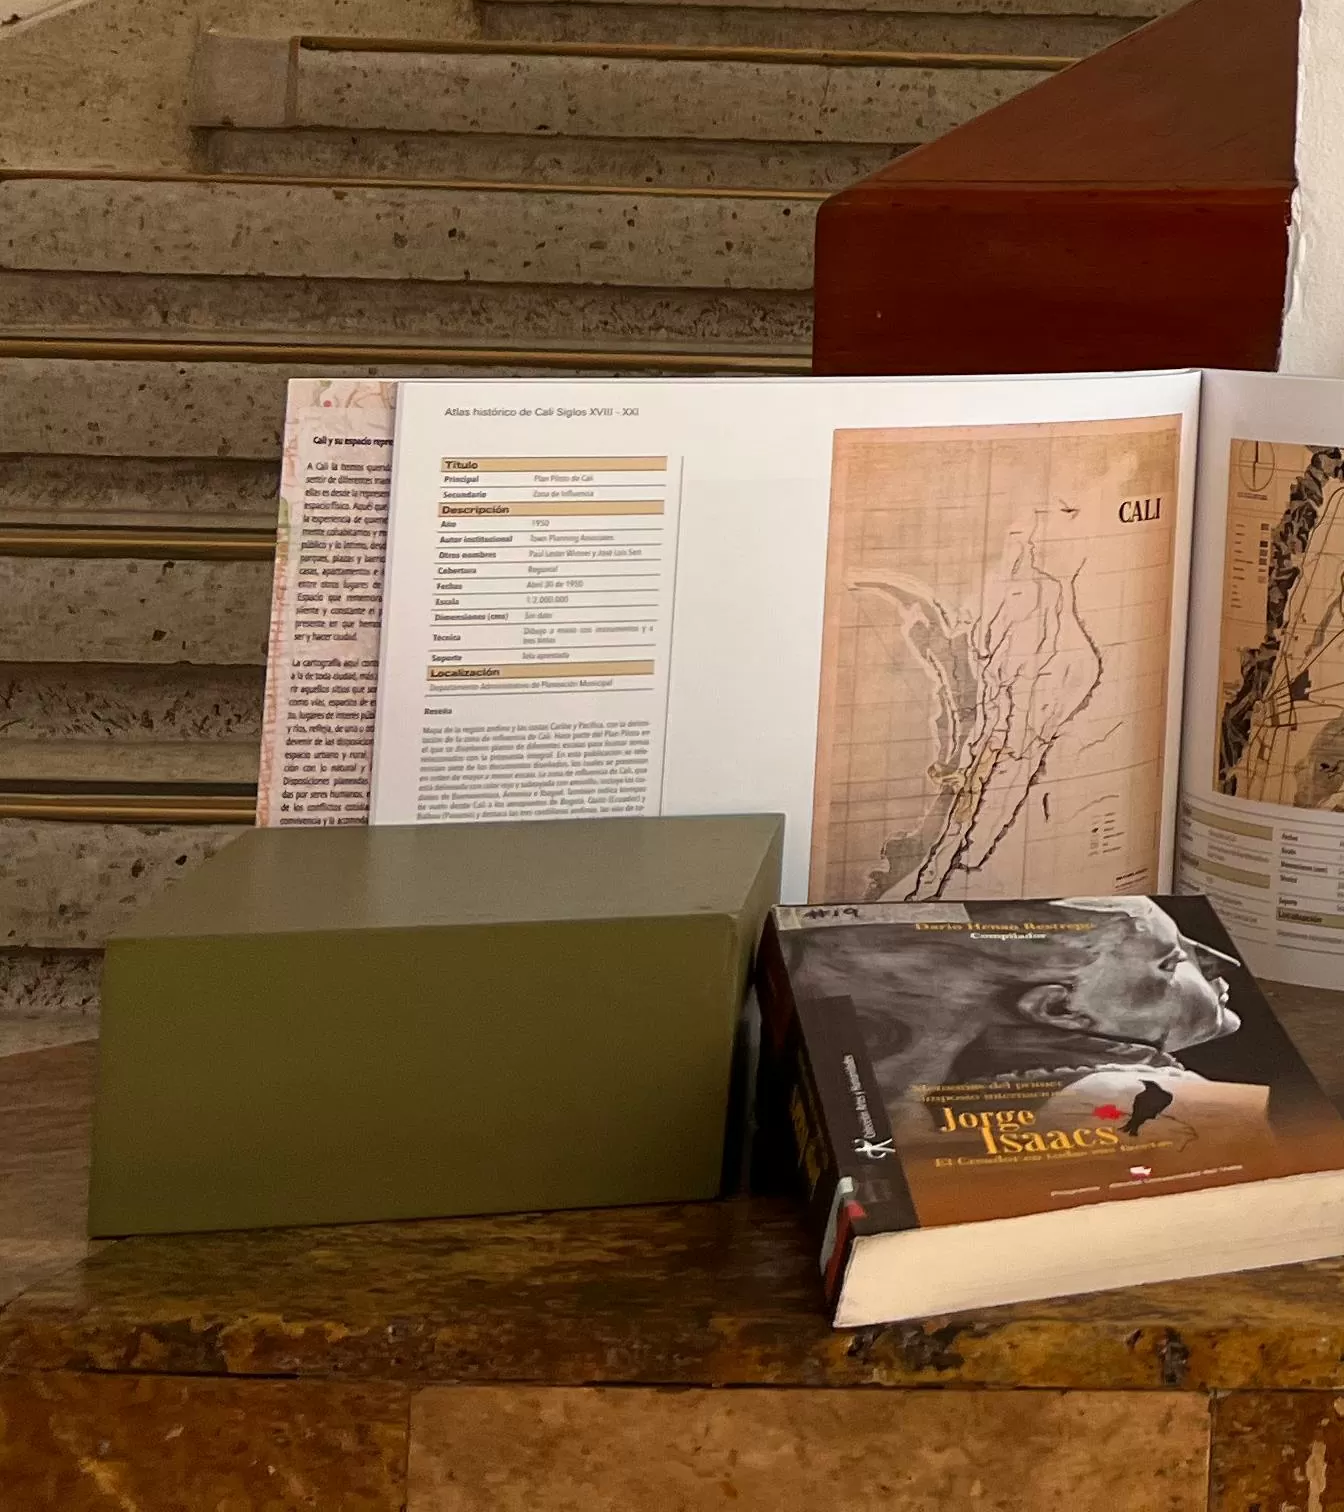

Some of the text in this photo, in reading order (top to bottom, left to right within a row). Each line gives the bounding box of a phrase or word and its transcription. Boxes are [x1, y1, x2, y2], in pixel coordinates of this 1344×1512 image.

[444, 406, 640, 419] Atlas histórico de Cali Siglos XVIII XXI
[444, 459, 479, 470] Título
[443, 474, 480, 485] Principal
[441, 504, 510, 516] Descripción
[1118, 498, 1162, 523] CALI
[430, 667, 500, 678] Localización
[940, 1106, 1037, 1133] Jorge
[980, 1125, 1120, 1155] Isaacs
